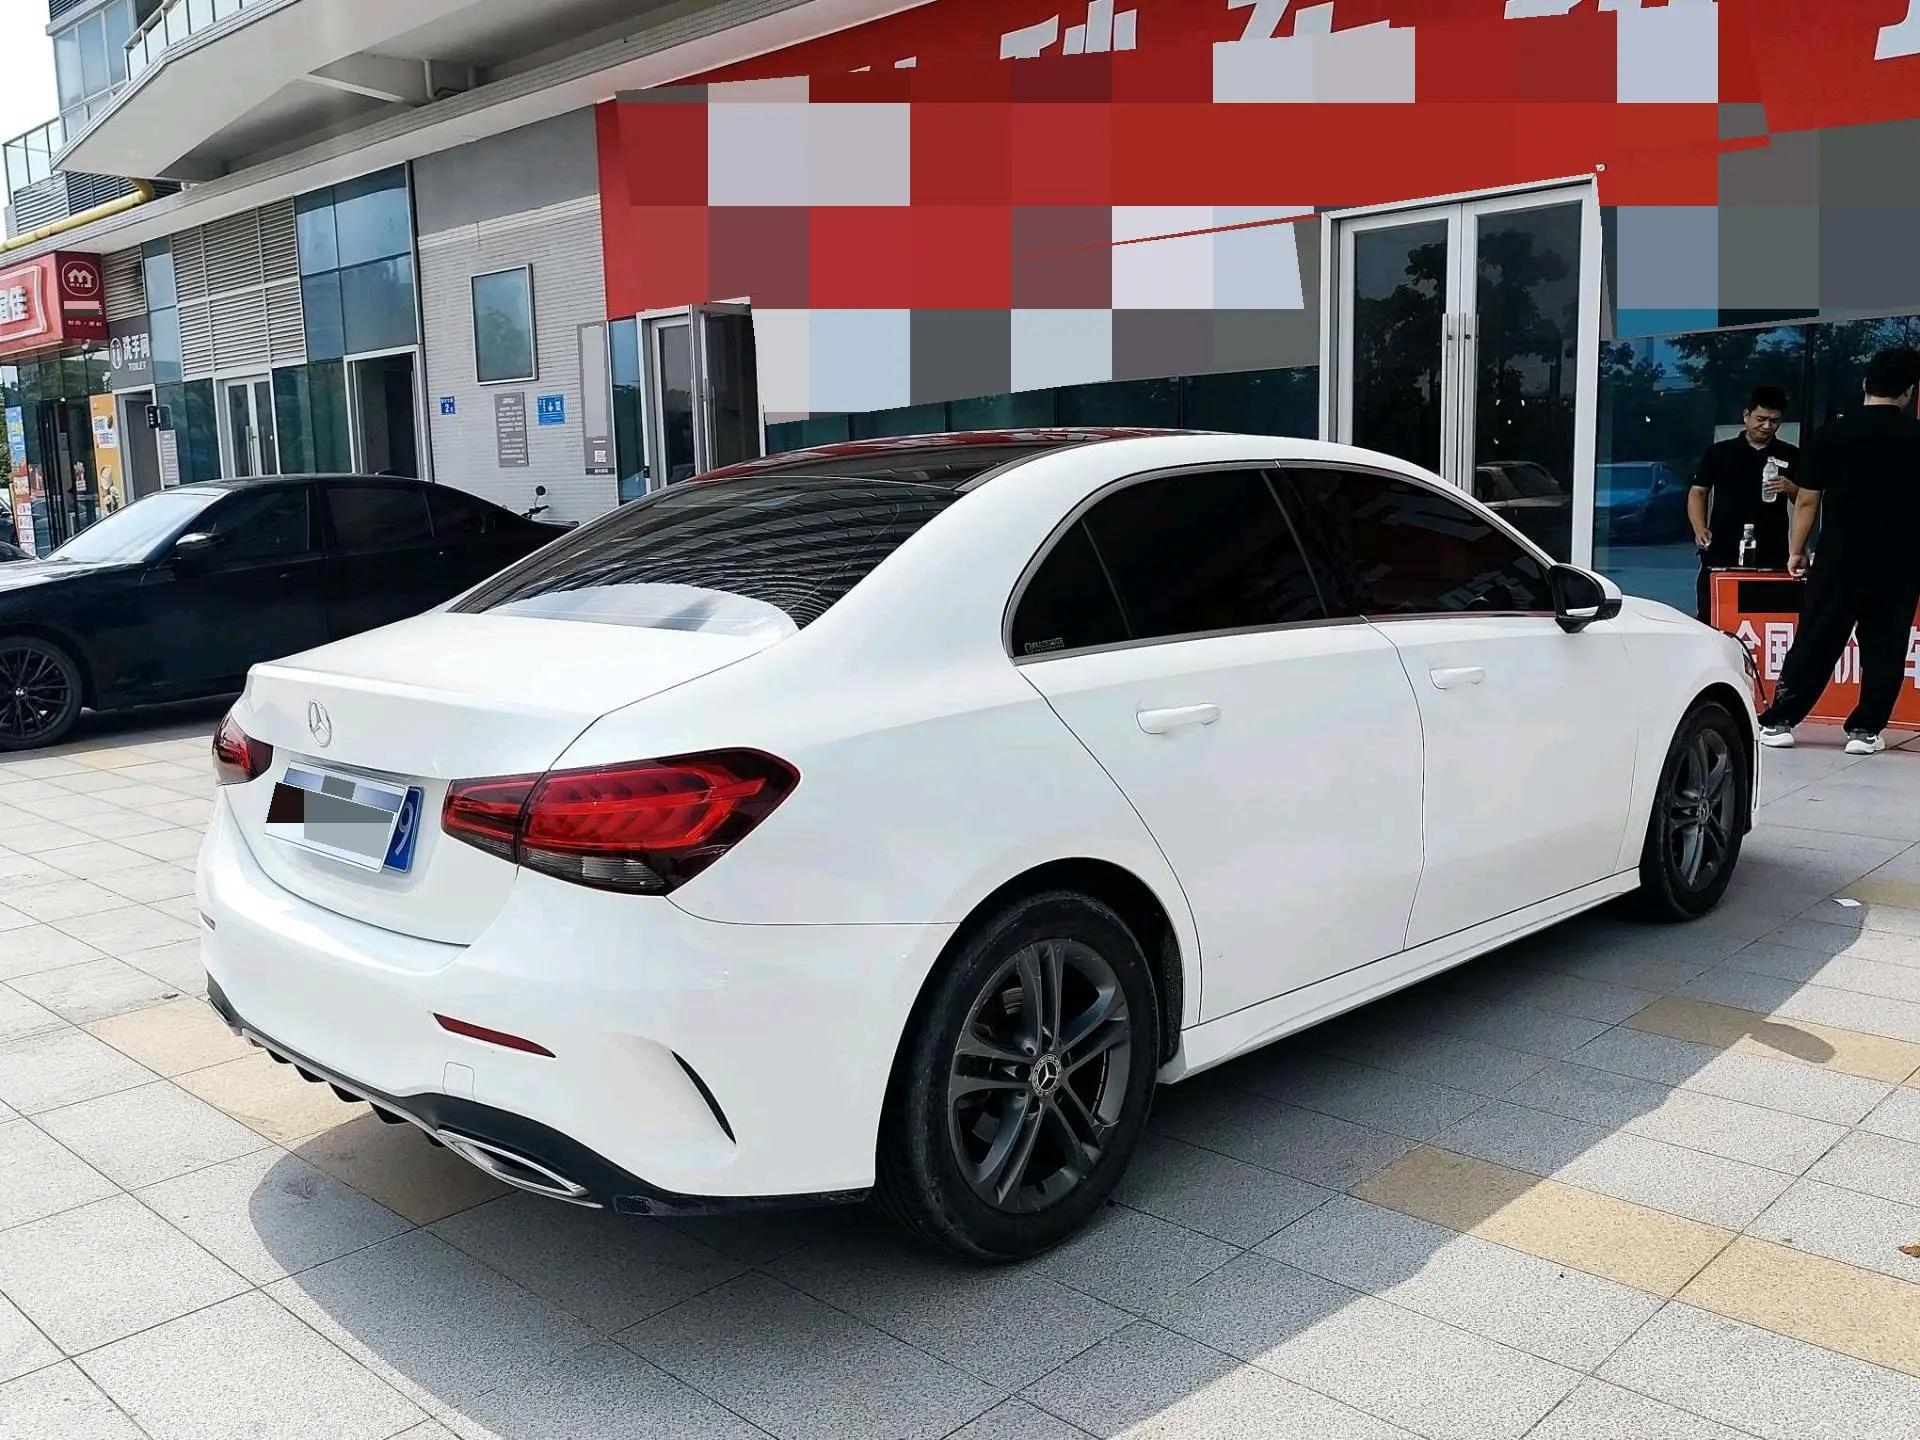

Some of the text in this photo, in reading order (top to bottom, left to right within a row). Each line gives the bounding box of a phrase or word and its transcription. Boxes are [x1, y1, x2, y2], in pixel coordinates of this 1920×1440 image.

[122, 333, 150, 360] 洗手间
[396, 802, 413, 855] 9
